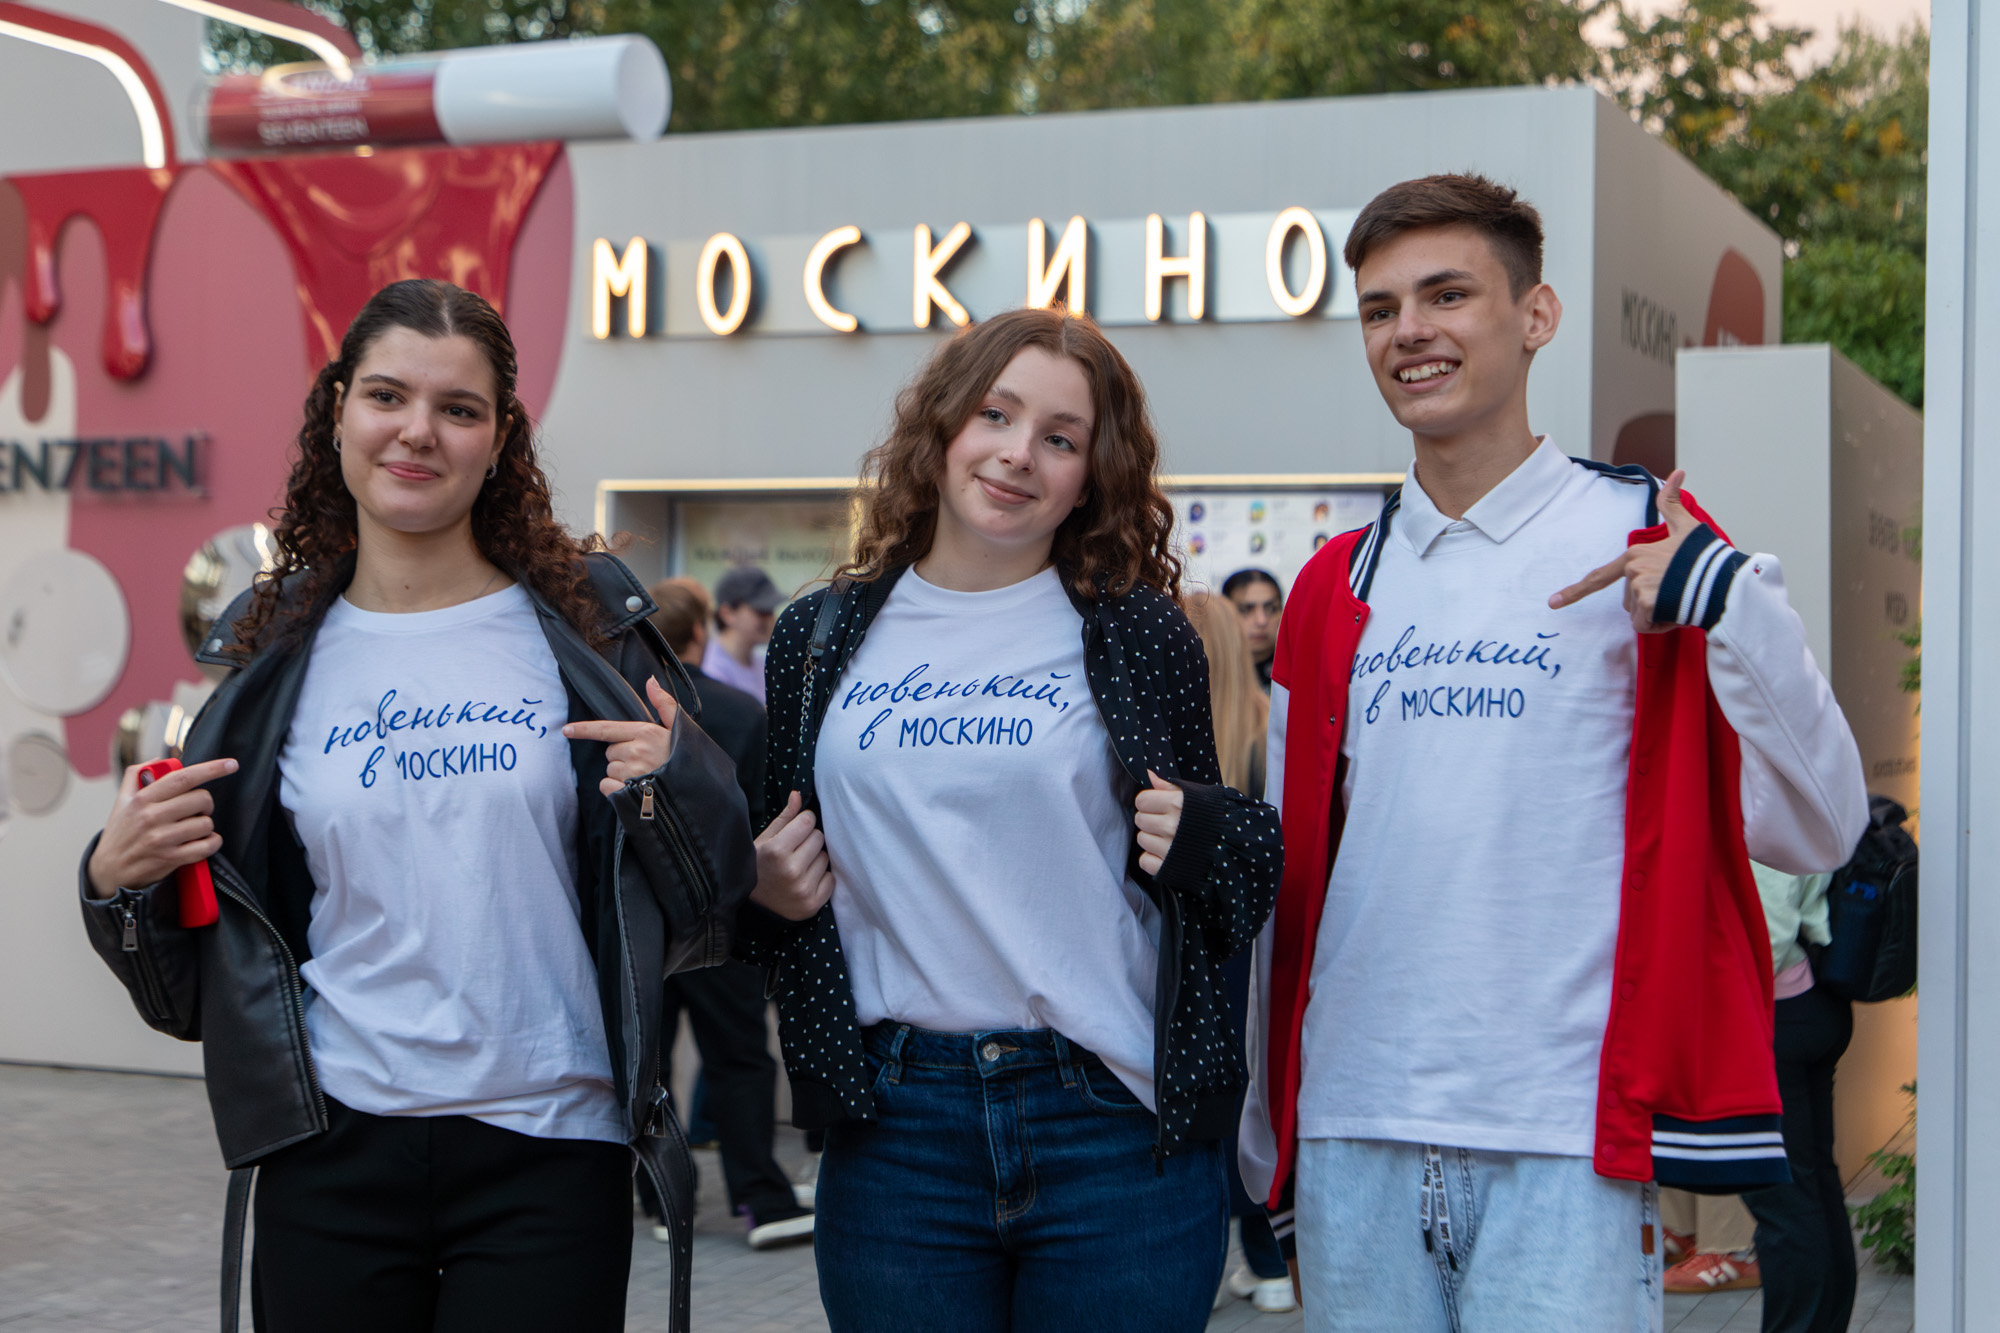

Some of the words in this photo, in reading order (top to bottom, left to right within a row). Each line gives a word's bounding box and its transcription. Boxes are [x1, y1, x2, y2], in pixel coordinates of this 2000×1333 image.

[592, 206, 1326, 339] МОСКИНО
[1349, 624, 1561, 684] новенький,
[841, 663, 1072, 713] новенький,
[1365, 679, 1391, 725] в
[1401, 686, 1525, 721] МОСКИНО
[323, 688, 548, 755] новенький,
[858, 708, 893, 750] в
[898, 716, 1034, 748] МОСКИНО
[358, 745, 385, 789] в
